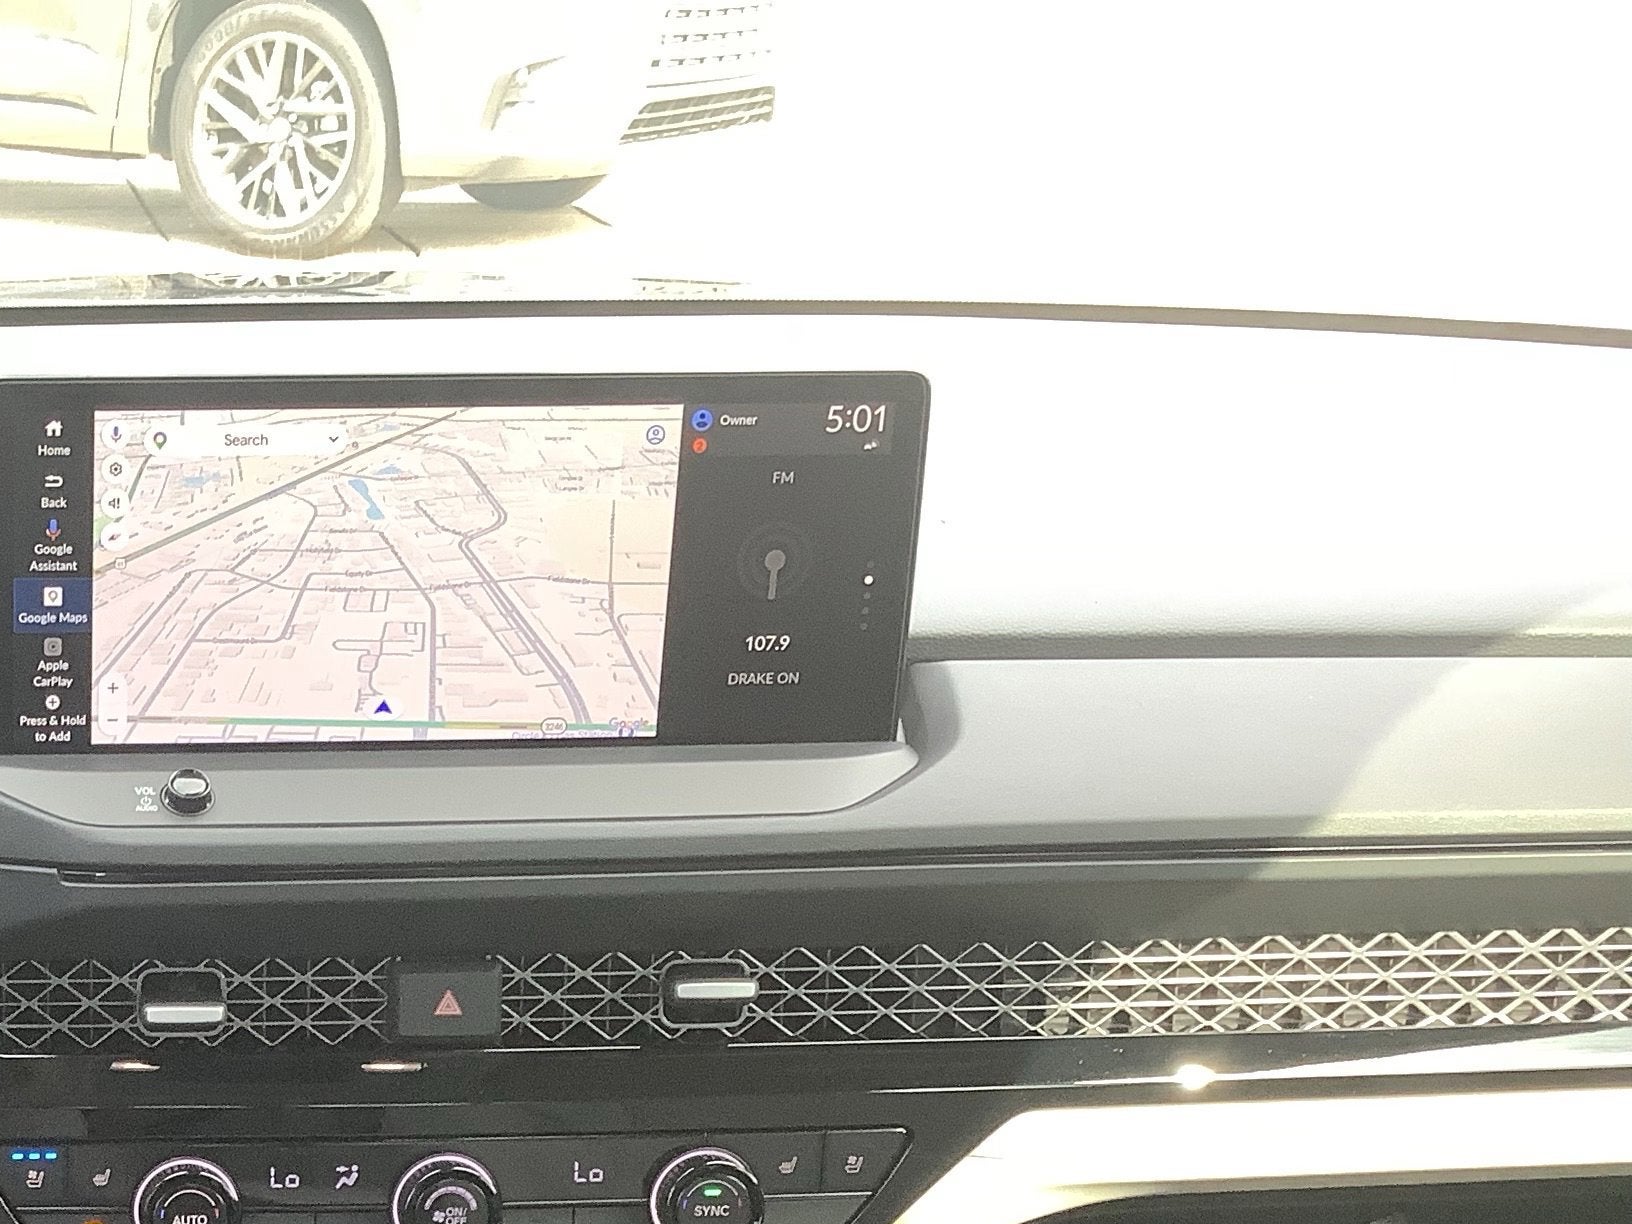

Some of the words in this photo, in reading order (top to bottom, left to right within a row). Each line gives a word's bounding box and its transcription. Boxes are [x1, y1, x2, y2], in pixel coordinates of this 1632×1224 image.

[720, 415, 758, 427] Owner
[825, 404, 888, 433] 5:01
[224, 433, 269, 447] Search
[37, 444, 71, 456] Home
[772, 471, 795, 484] FM
[40, 497, 67, 509] Back
[34, 544, 73, 557] Google
[29, 559, 78, 572] Assistant
[18, 613, 57, 626] Google
[59, 613, 88, 625] Maps
[745, 635, 791, 651] 107.9
[37, 660, 69, 673] Apple
[33, 676, 73, 689] CarPlay
[727, 672, 774, 685] DRAKE
[777, 671, 800, 684] ON
[19, 715, 48, 727] Press
[50, 715, 58, 727] &
[61, 714, 86, 726] Hold
[35, 732, 47, 742] to
[50, 731, 71, 742] Add
[134, 786, 156, 796] VOL
[693, 1205, 730, 1217] SYNC
